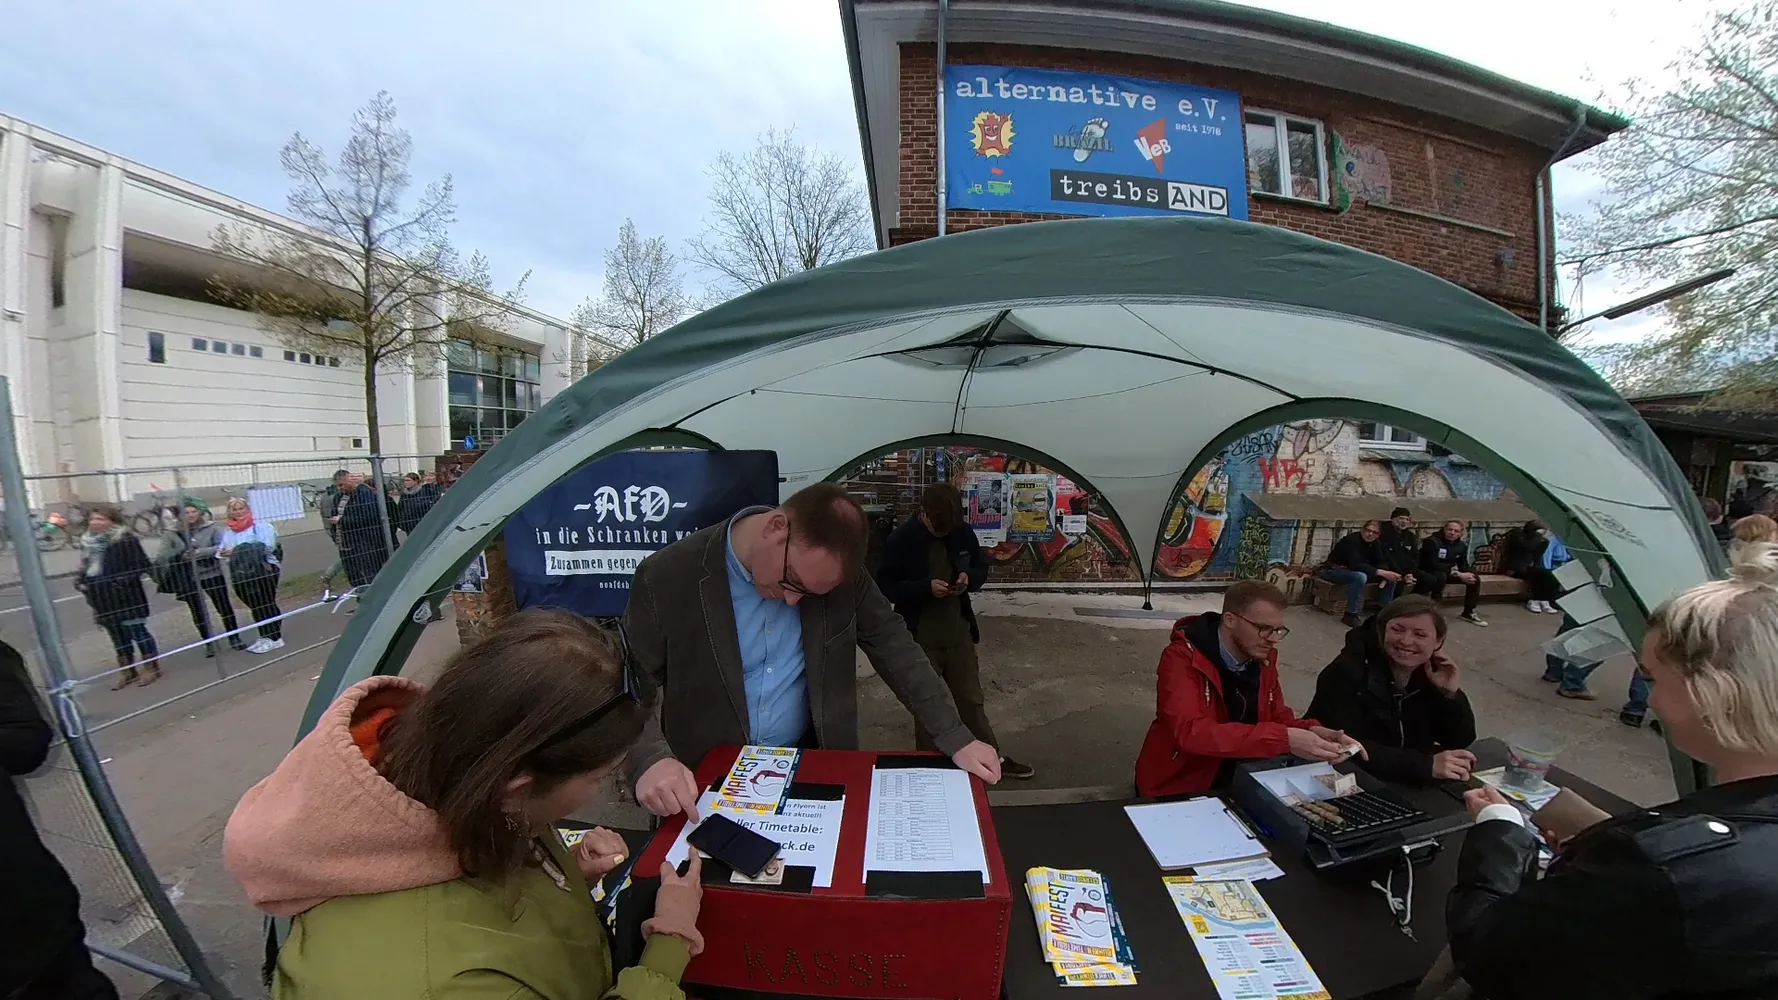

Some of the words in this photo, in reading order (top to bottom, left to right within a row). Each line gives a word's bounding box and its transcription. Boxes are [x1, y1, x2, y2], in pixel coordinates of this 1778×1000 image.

[956, 77, 1157, 111] alternative
[1178, 97, 1227, 121] e.V.
[1175, 122, 1198, 132] seit
[1201, 125, 1222, 136] 1978
[1053, 134, 1113, 151] BRAZIL
[1134, 136, 1171, 161] VeB
[535, 528, 551, 544] in
[558, 527, 579, 544] die
[587, 526, 668, 544] Schranken
[551, 556, 603, 571] Zusammen
[607, 557, 637, 571] gegen
[722, 755, 767, 799] MAIFEST
[759, 820, 824, 834] Timetable:
[1048, 881, 1082, 939] MAIFEST
[744, 942, 907, 987] KASSE
